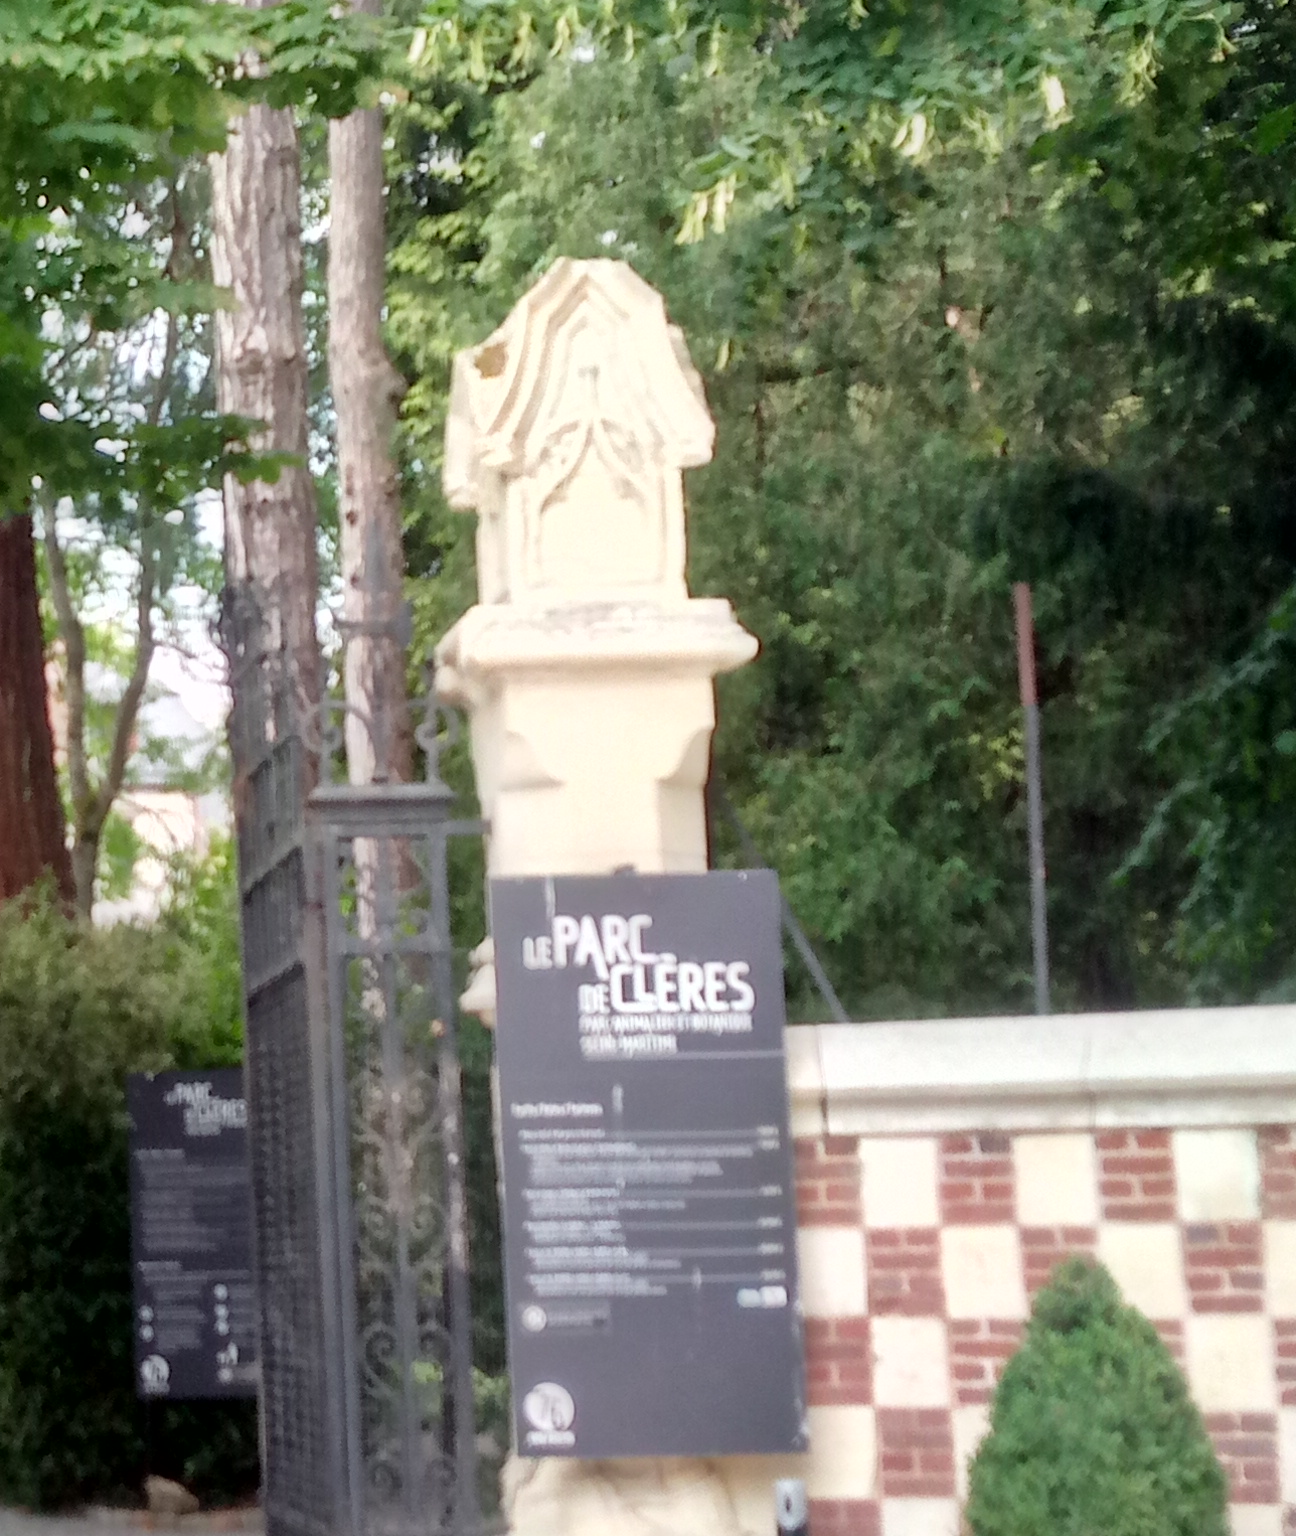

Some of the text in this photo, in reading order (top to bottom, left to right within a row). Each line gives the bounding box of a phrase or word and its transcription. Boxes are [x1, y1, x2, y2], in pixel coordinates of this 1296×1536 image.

[522, 914, 660, 980] LE PARC
[578, 984, 610, 1014] DE
